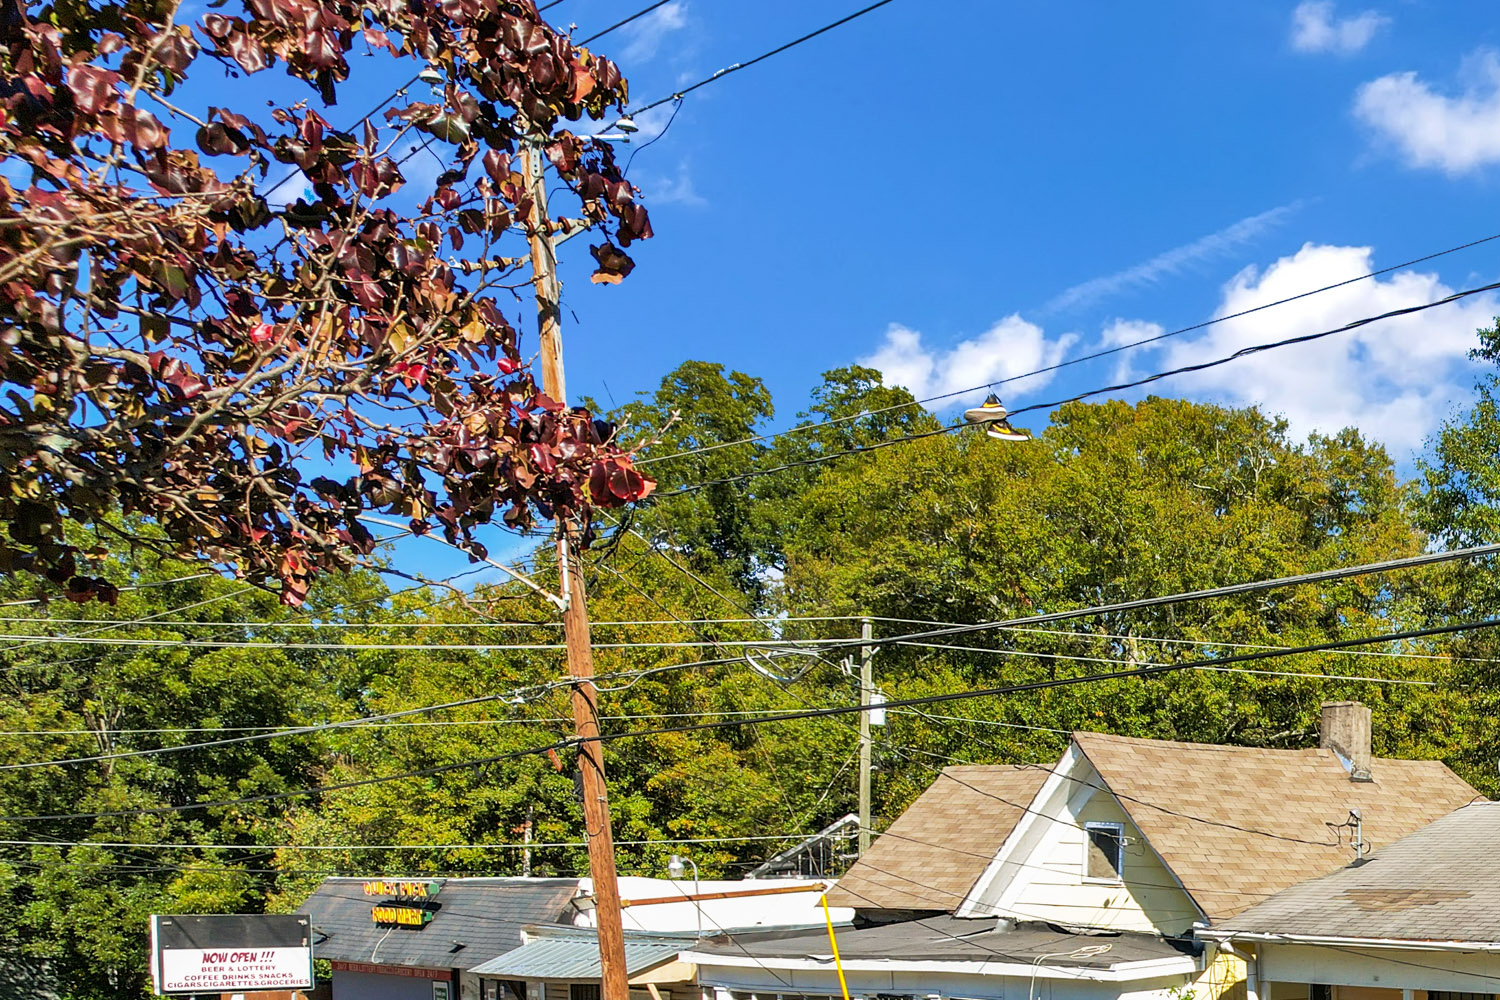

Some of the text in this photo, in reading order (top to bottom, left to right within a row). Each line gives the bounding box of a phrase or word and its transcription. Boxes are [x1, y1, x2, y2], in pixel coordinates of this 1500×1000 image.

[362, 881, 427, 896] QUICK PICK
[371, 906, 422, 925] FOOD MART
[202, 951, 275, 964] NOW OPEN !!!
